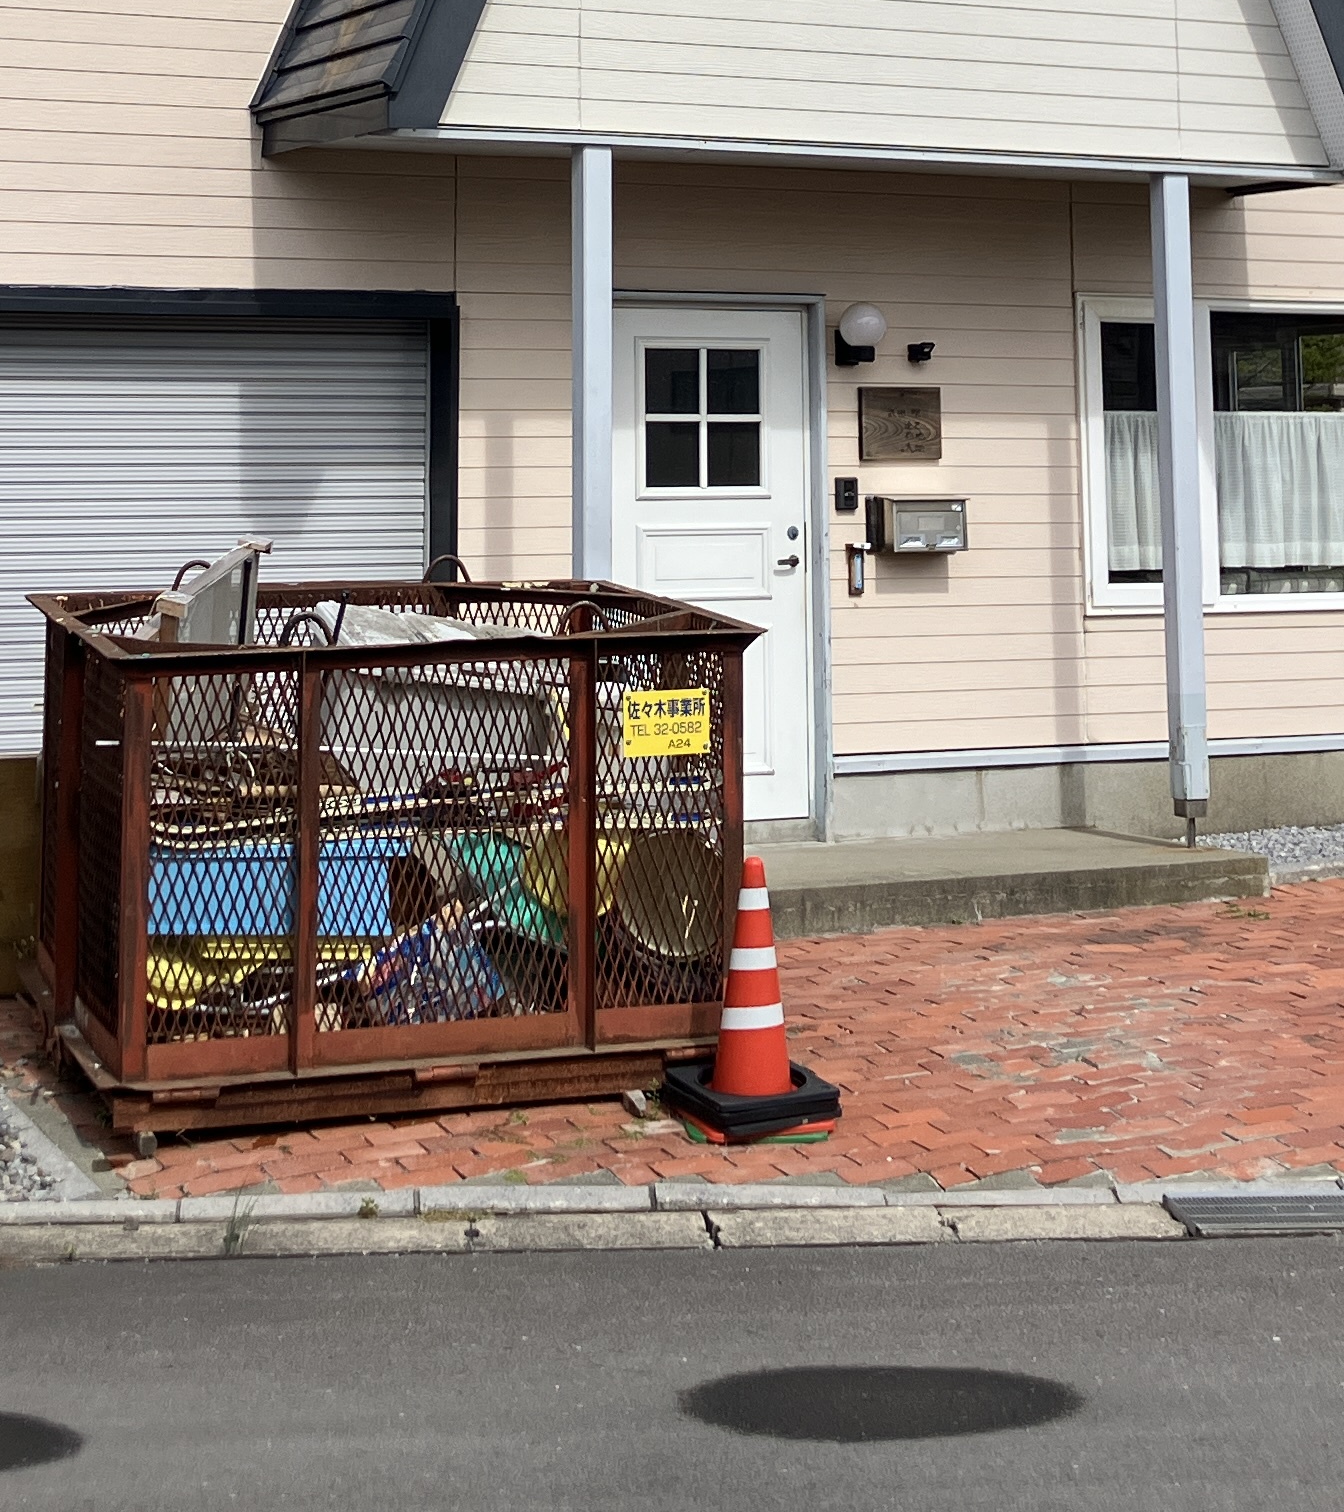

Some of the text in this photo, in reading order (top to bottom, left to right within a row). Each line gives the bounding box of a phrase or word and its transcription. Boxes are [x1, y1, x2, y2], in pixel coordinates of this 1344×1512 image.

[628, 698, 705, 719] 佐々木事業所
[630, 721, 702, 737] TEL 32-0582
[668, 739, 691, 749] A24
